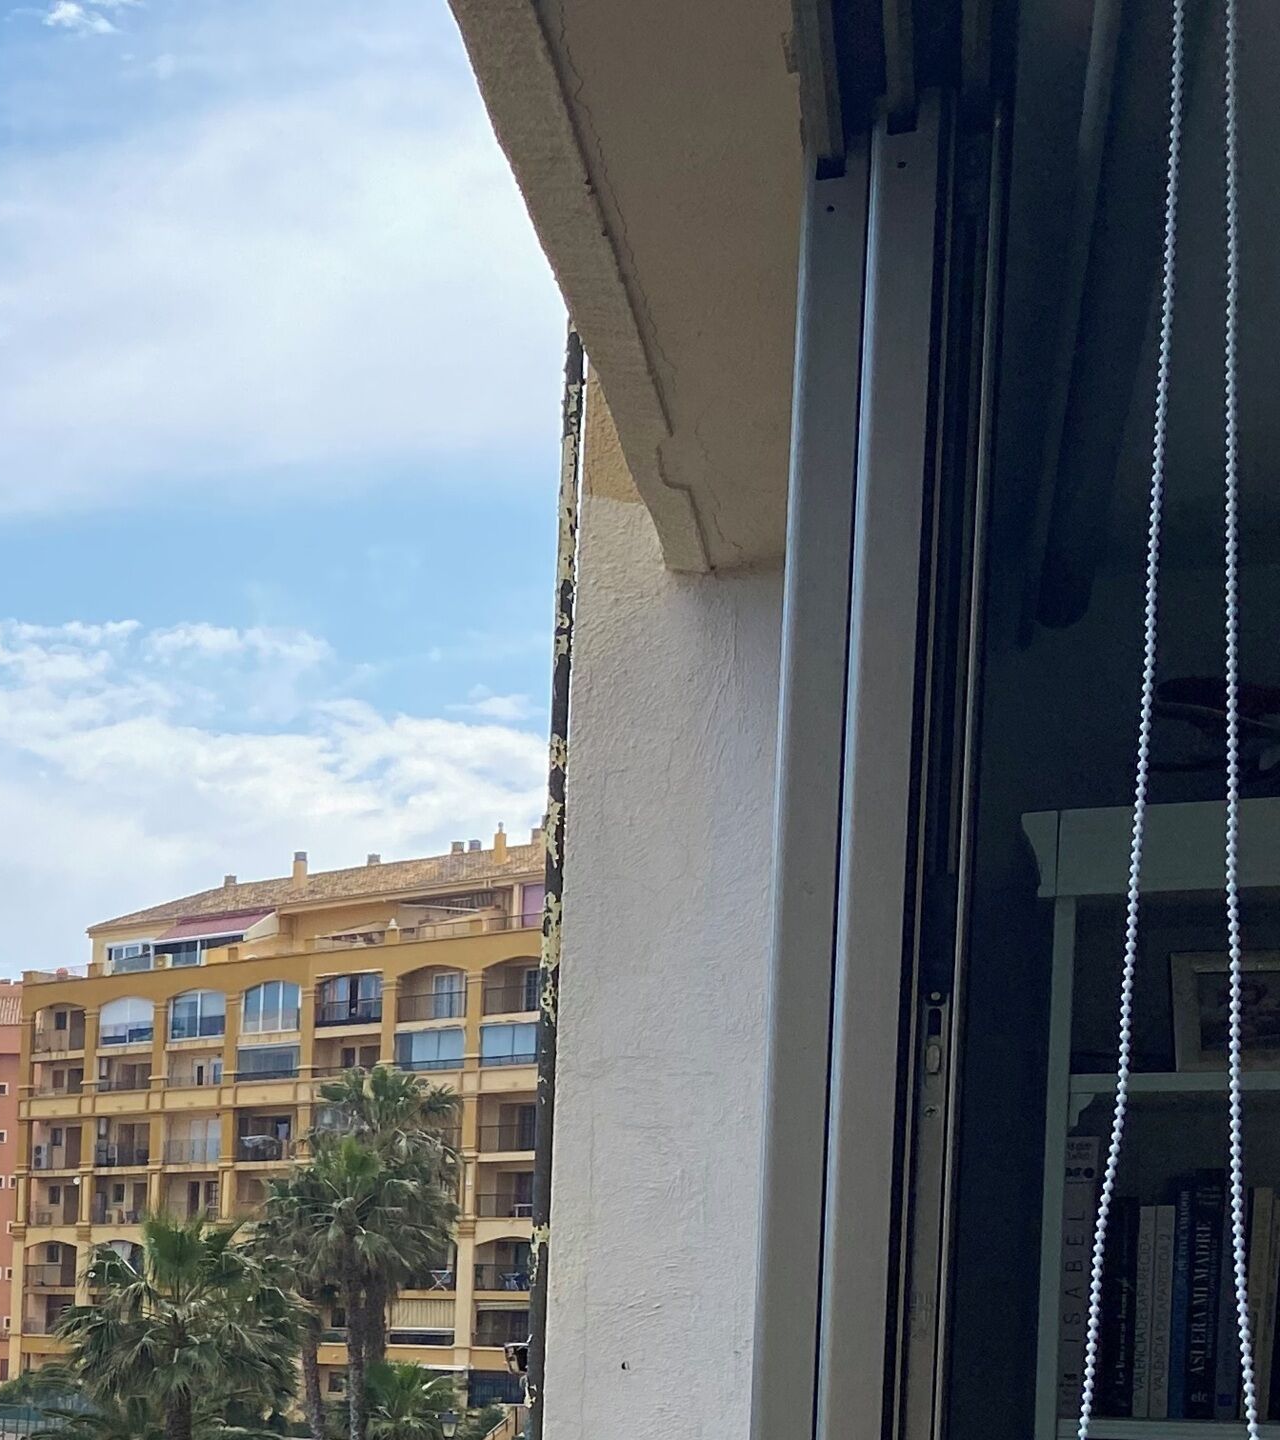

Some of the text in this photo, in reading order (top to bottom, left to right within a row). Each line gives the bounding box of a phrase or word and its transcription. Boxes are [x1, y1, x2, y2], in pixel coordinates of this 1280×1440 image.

[1194, 1221, 1211, 1282] MADRE
[1063, 1209, 1086, 1344] ISABEL
[1193, 1286, 1208, 1308] MI
[1191, 1311, 1207, 1344] ERA
